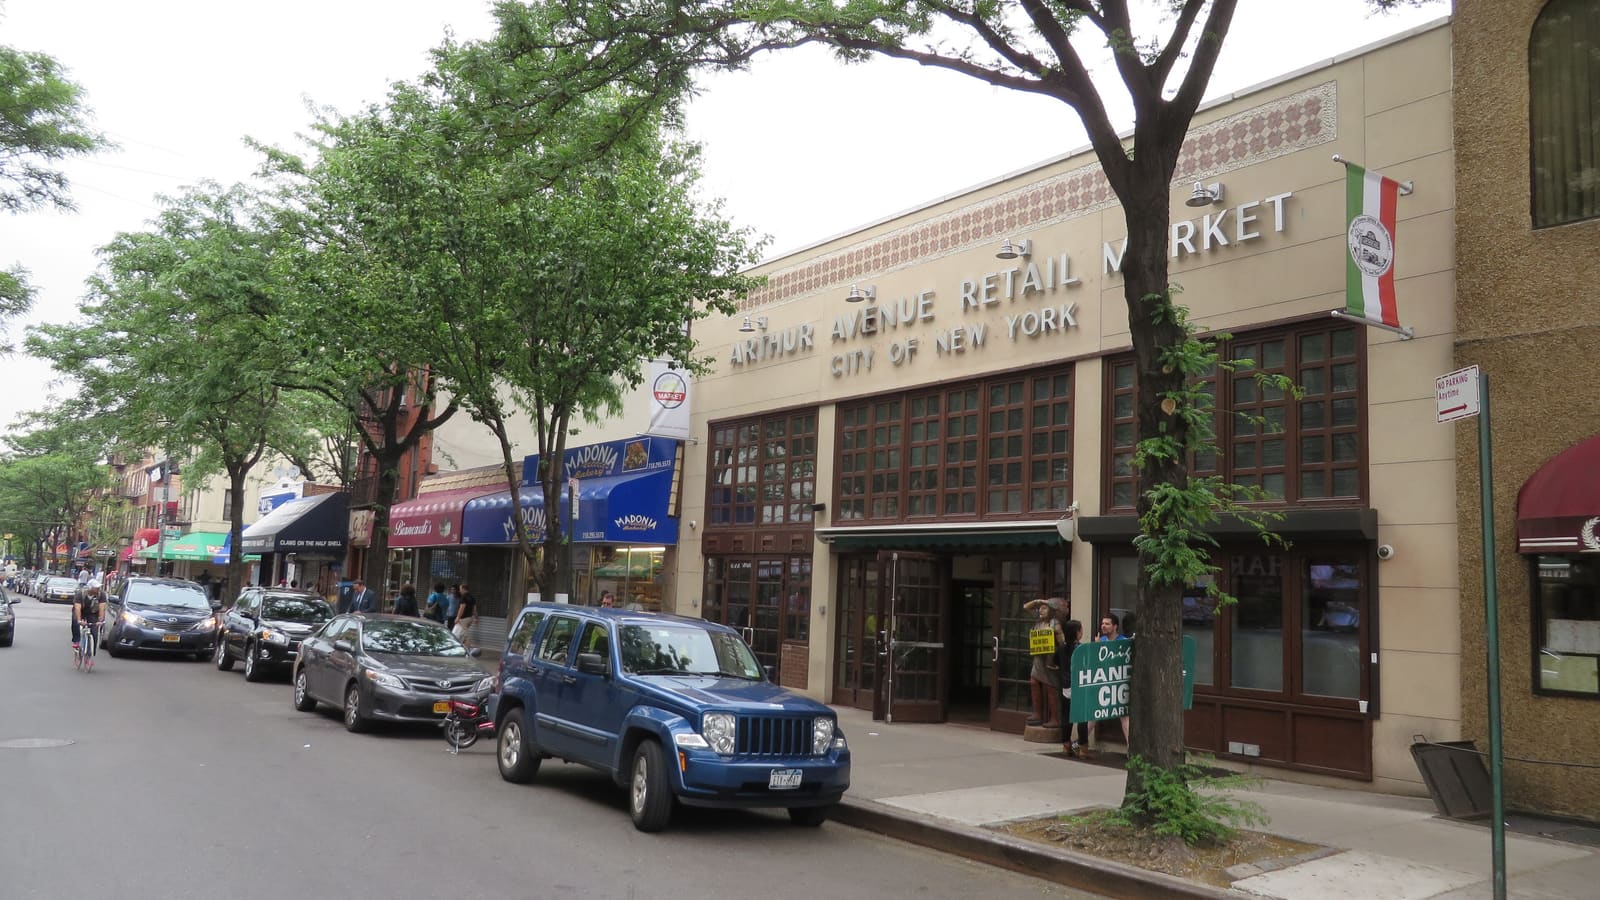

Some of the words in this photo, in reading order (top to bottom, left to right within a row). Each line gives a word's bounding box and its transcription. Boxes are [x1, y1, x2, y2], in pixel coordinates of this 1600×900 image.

[730, 323, 814, 366] ARTHUR
[831, 290, 935, 341] AVENUE
[960, 253, 1079, 310] RETAIL
[1103, 192, 1293, 276] MRKET
[831, 348, 874, 377] CITY
[889, 338, 917, 364] OF
[936, 322, 987, 352] NEW
[1006, 302, 1079, 339] YORK
[1438, 381, 1445, 390] NO
[1446, 374, 1468, 386] PARKING
[1438, 388, 1459, 399] Anytime
[565, 445, 618, 476] MADONIA
[503, 507, 547, 537] MDONI
[614, 514, 657, 530] MADONIA
[1094, 708, 1108, 719] ON
